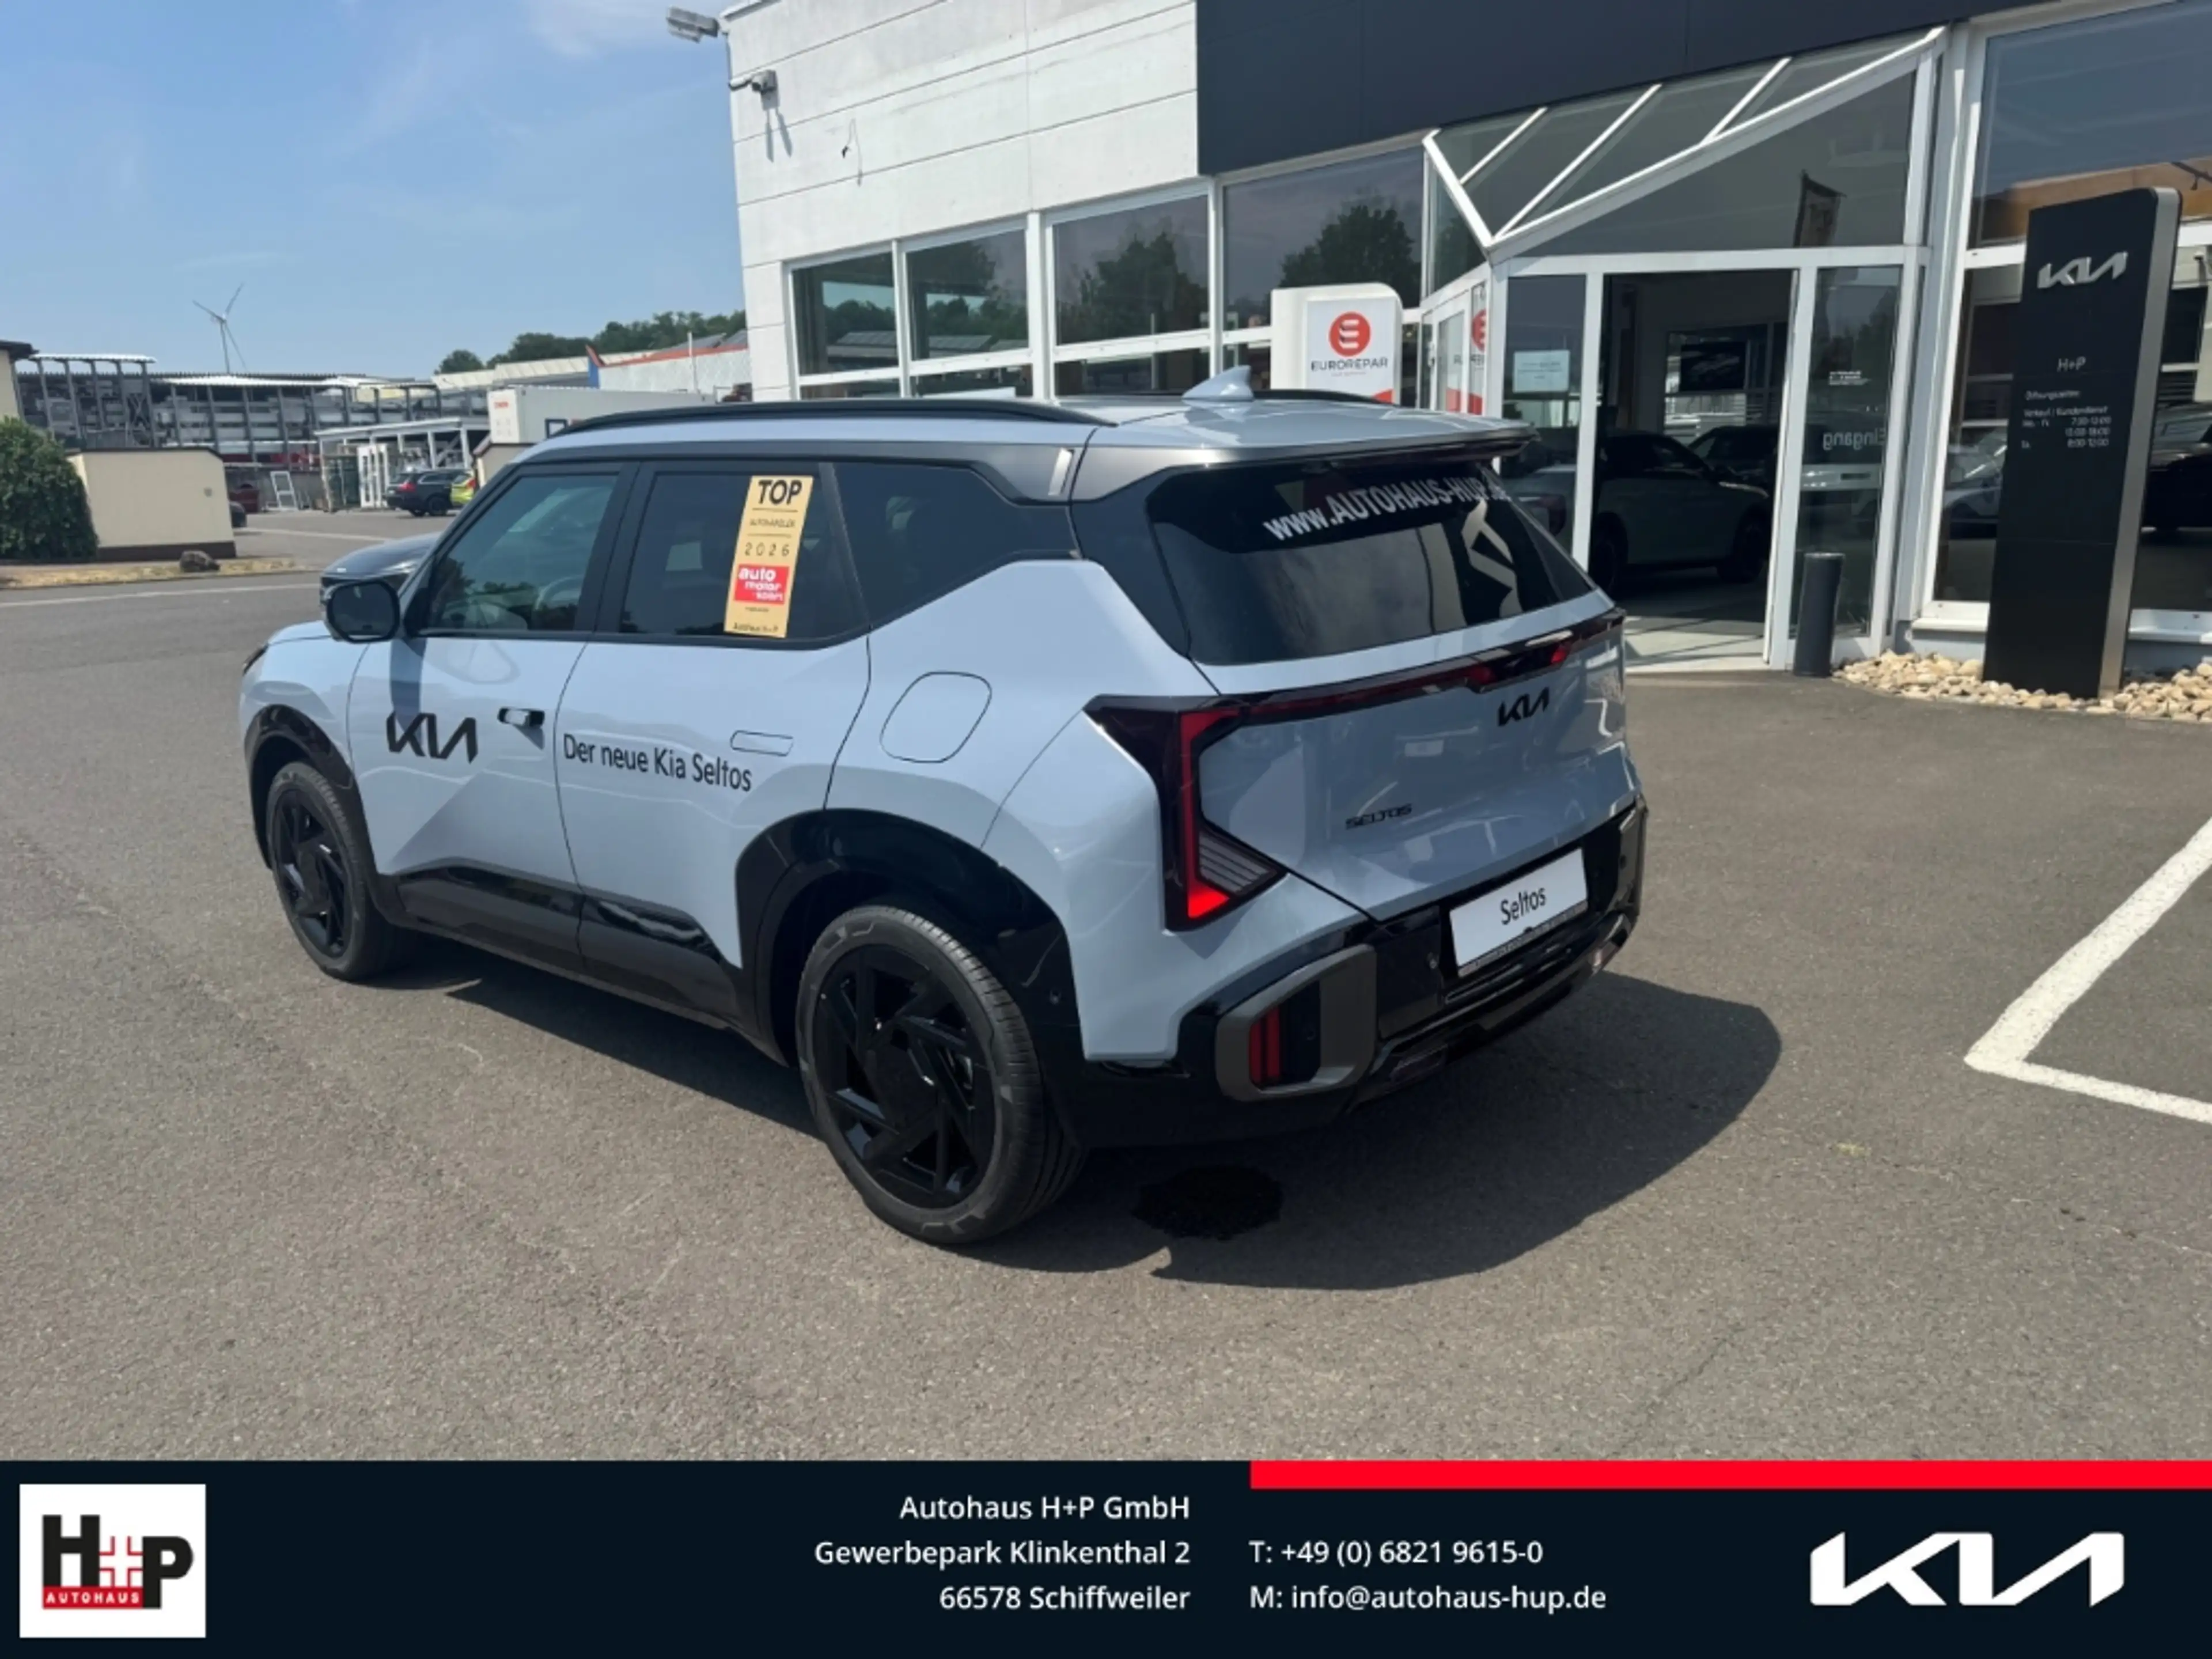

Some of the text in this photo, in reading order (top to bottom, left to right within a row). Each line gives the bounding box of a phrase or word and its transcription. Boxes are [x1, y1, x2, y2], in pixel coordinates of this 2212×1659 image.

[2037, 251, 2128, 289] KIA
[758, 479, 802, 505] TOP
[738, 567, 777, 581] auto
[1499, 687, 1550, 726] KIA
[386, 710, 478, 764] KIA
[563, 733, 752, 792] Der neue Kia Seltos
[1501, 887, 1546, 926] Seltos
